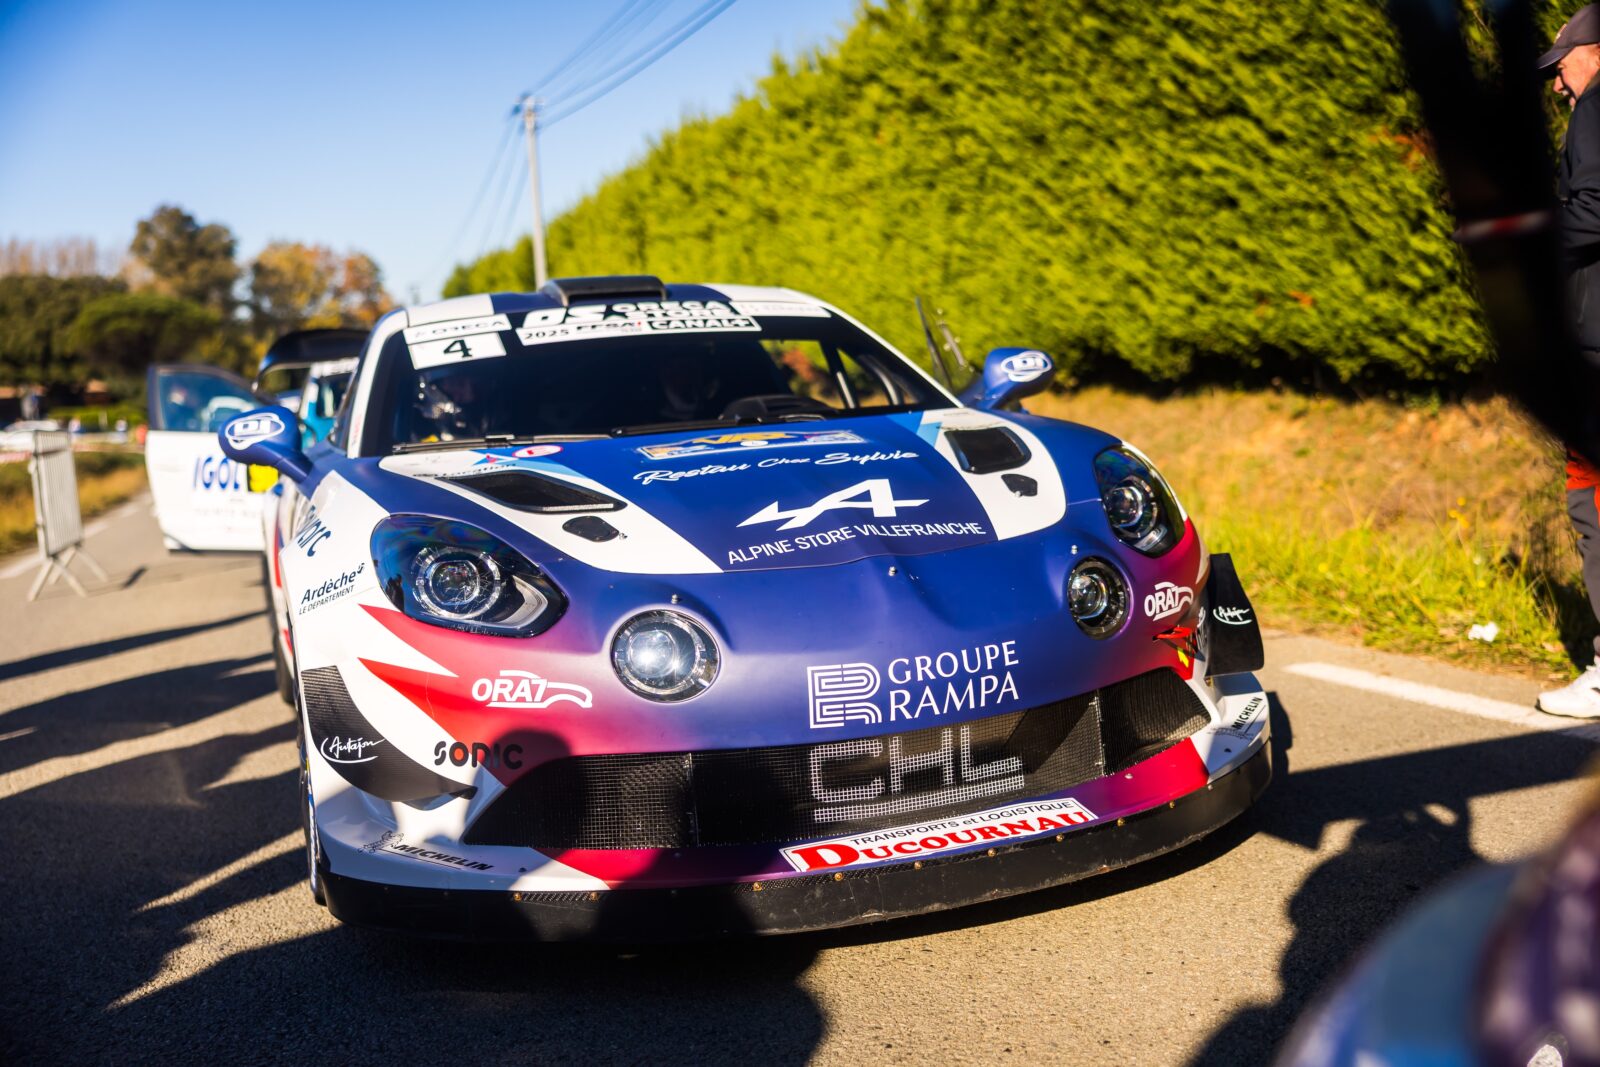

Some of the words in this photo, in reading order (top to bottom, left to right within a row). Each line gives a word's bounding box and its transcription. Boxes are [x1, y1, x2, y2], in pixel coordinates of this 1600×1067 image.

[443, 339, 473, 358] 4
[524, 328, 570, 340] 2025
[192, 456, 240, 490] IGOL
[633, 462, 752, 485] Restau
[757, 456, 811, 468] Chez
[814, 449, 920, 465] Sylvie
[728, 539, 794, 564] ALPINE
[795, 526, 856, 550] STORE
[853, 522, 987, 537] VILLEFRANCHE
[301, 569, 357, 604] Ardèche
[299, 605, 307, 615] LE
[888, 640, 1019, 685] GROUPE
[889, 671, 1020, 722] RAMPA
[1231, 696, 1263, 730] MICHELIN
[810, 724, 1023, 803] CHL
[851, 820, 959, 847] TRANSPORTS
[964, 816, 979, 828] et
[978, 801, 1075, 824] LOGISTIQUE
[392, 843, 496, 872] MICHELIN
